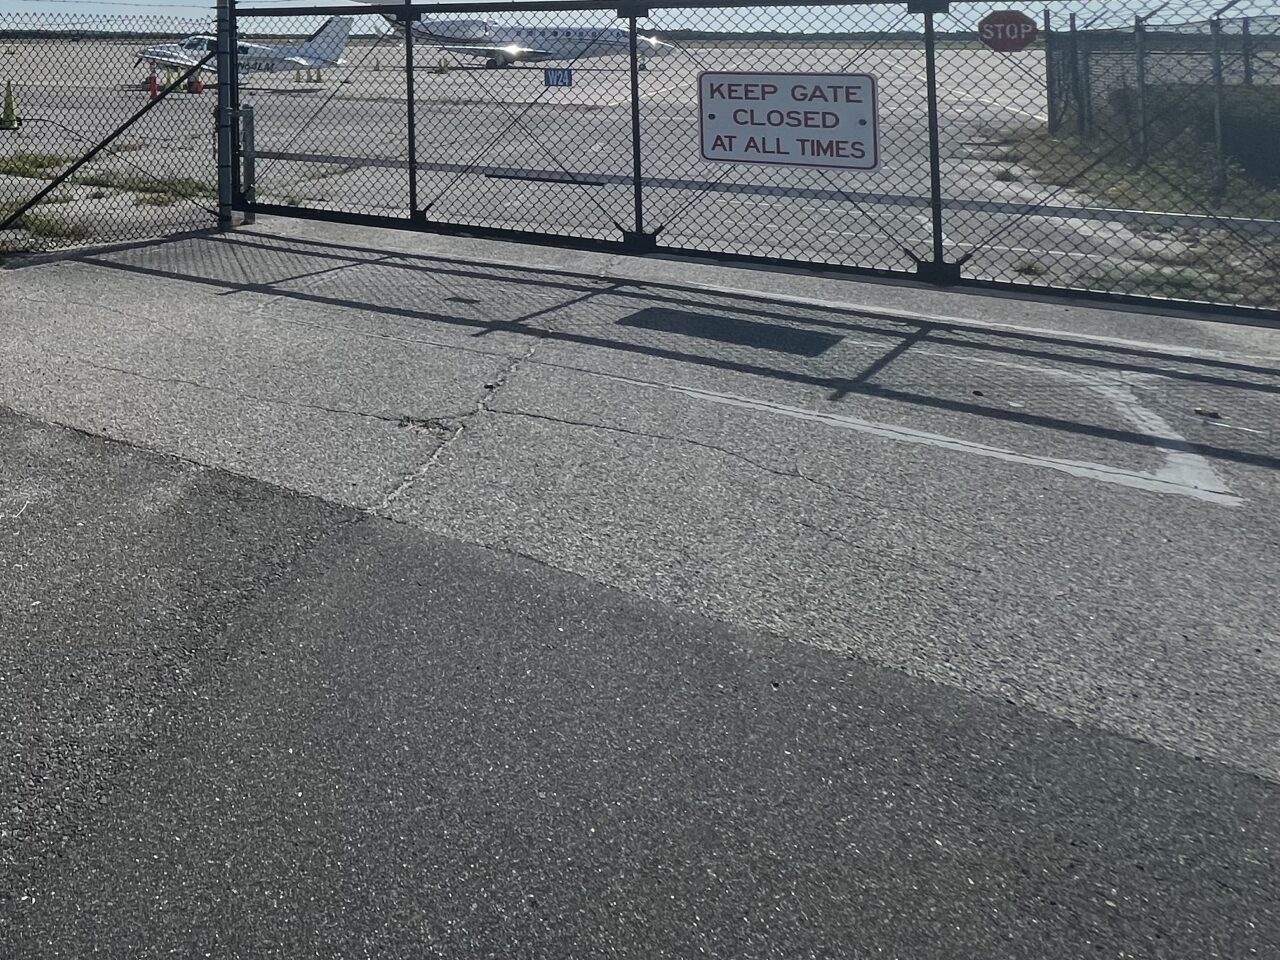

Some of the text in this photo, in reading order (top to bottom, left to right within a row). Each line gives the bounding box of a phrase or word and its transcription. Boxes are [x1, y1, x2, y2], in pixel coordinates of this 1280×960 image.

[982, 23, 1033, 39] STOP
[548, 70, 569, 85] W24
[710, 83, 863, 103] KEEP GATE
[732, 108, 840, 129] CLOSED
[711, 135, 866, 159] AT ALL TIMES
